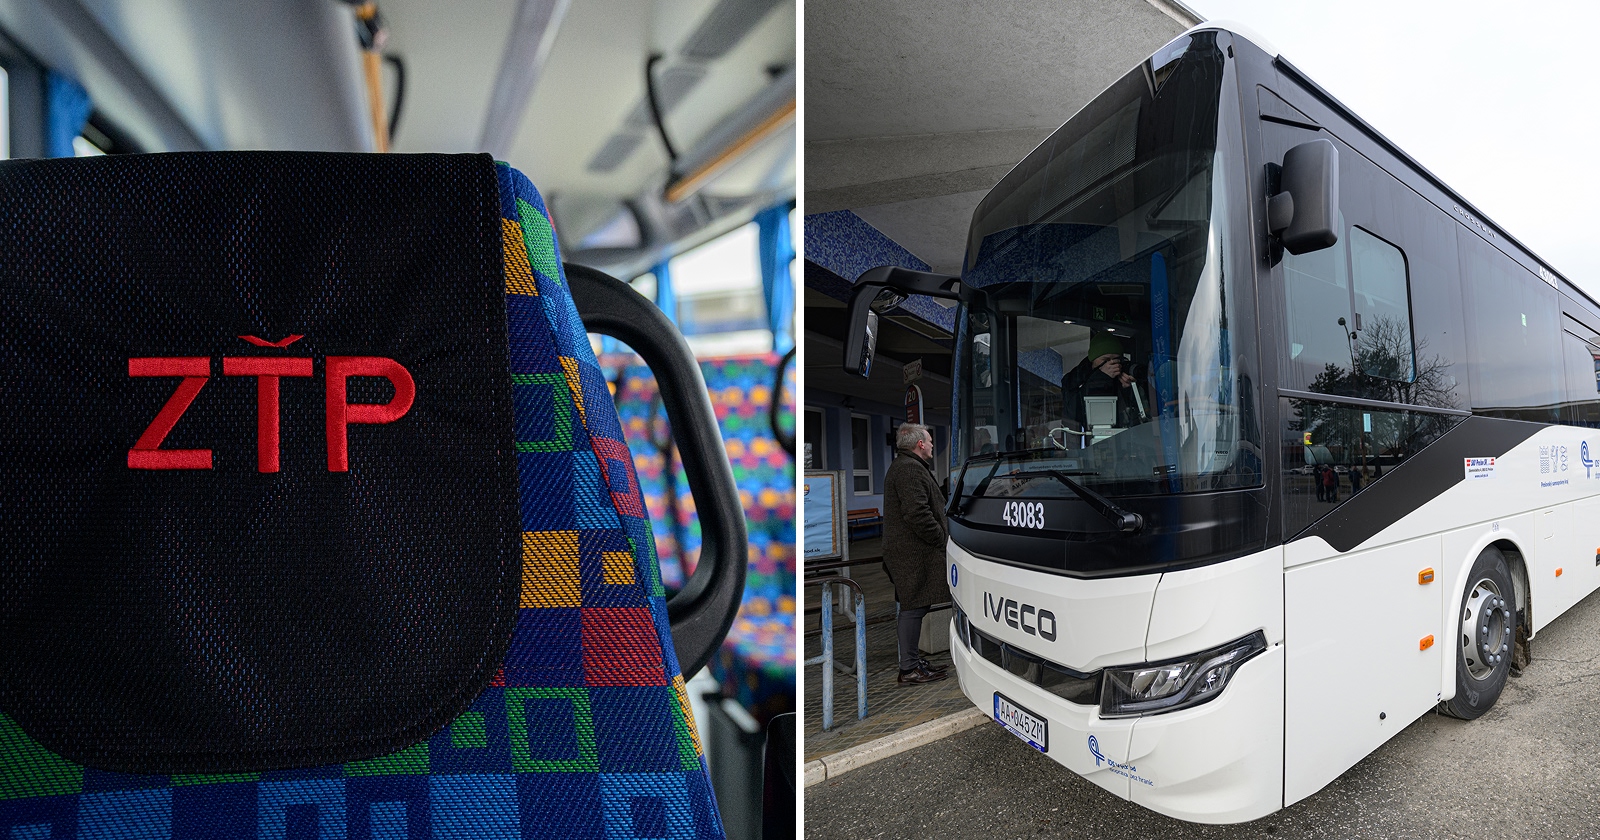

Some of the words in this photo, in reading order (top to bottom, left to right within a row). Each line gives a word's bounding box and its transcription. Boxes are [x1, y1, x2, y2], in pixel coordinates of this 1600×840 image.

[127, 334, 416, 473] ZŤP
[907, 390, 916, 402] 20
[1002, 501, 1045, 529] 43083
[983, 591, 1057, 642] IVECO
